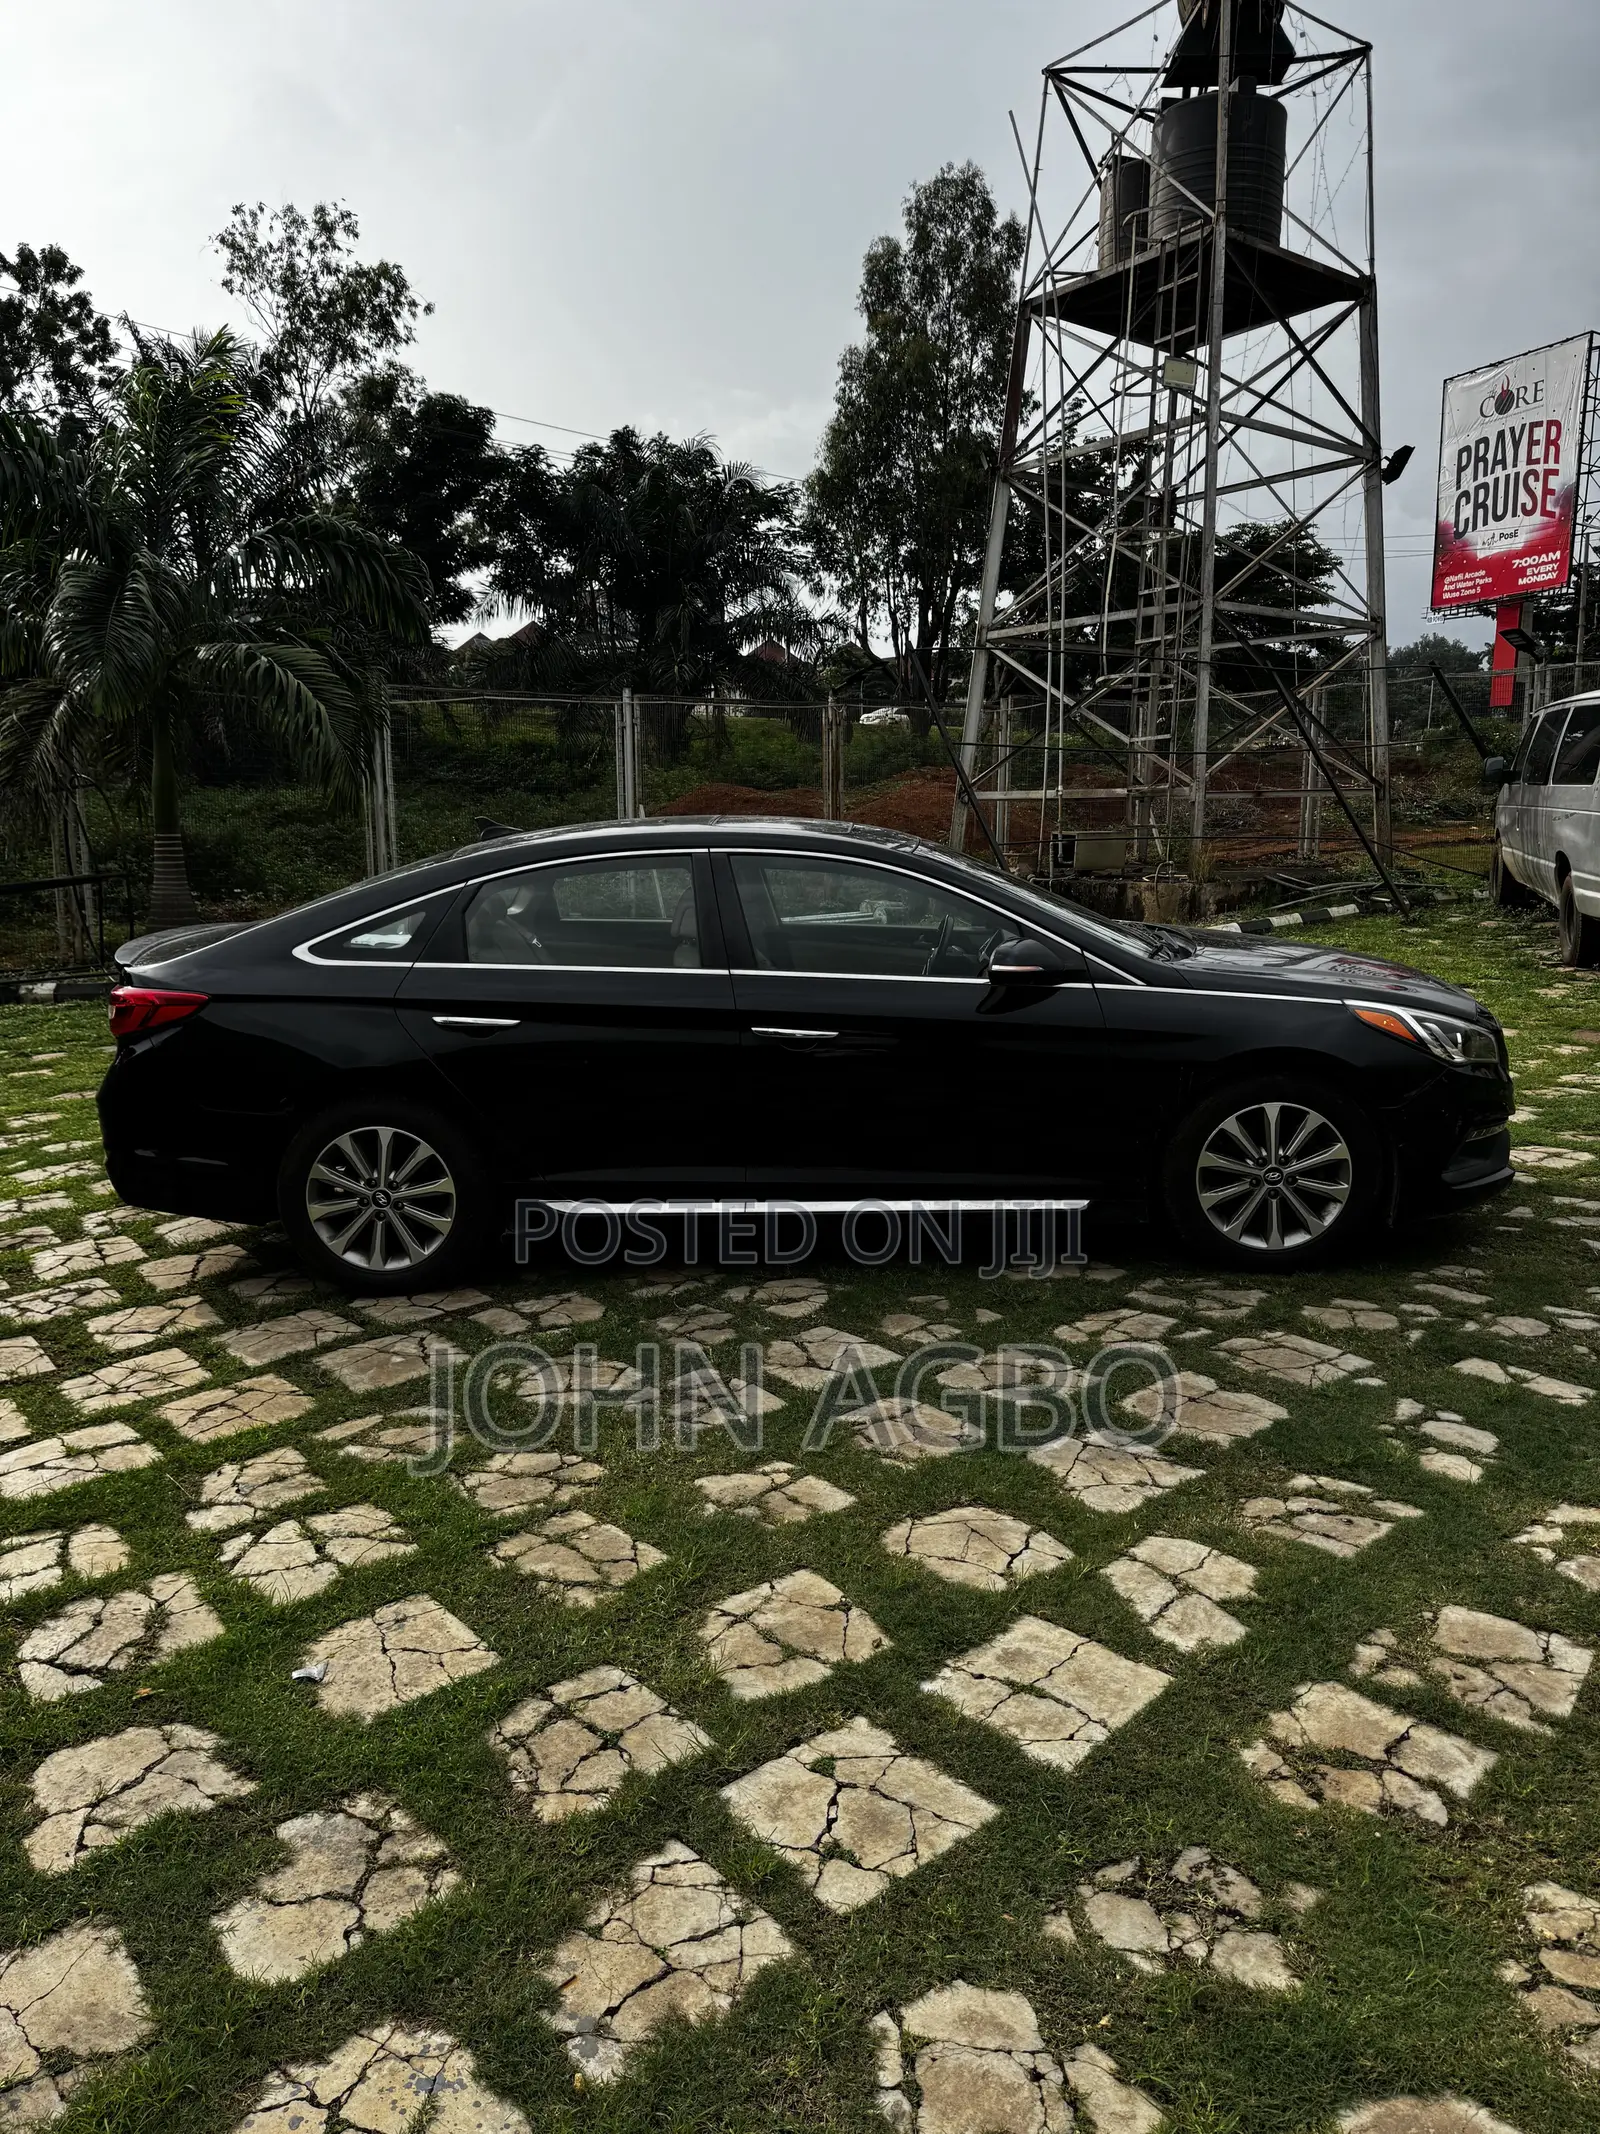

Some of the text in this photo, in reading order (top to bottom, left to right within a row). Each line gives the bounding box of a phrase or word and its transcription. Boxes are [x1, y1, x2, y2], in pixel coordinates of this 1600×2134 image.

[1455, 419, 1562, 491] PRAYER
[1454, 468, 1560, 540] CRUISE
[1512, 550, 1561, 569] 7:00AM
[1464, 569, 1486, 580] Arcade
[1526, 562, 1559, 576] EVERY
[1443, 576, 1493, 591] And Water Parks
[1518, 571, 1559, 585] MONDAY
[1442, 590, 1460, 599] Wuse
[1460, 588, 1476, 597] Zone
